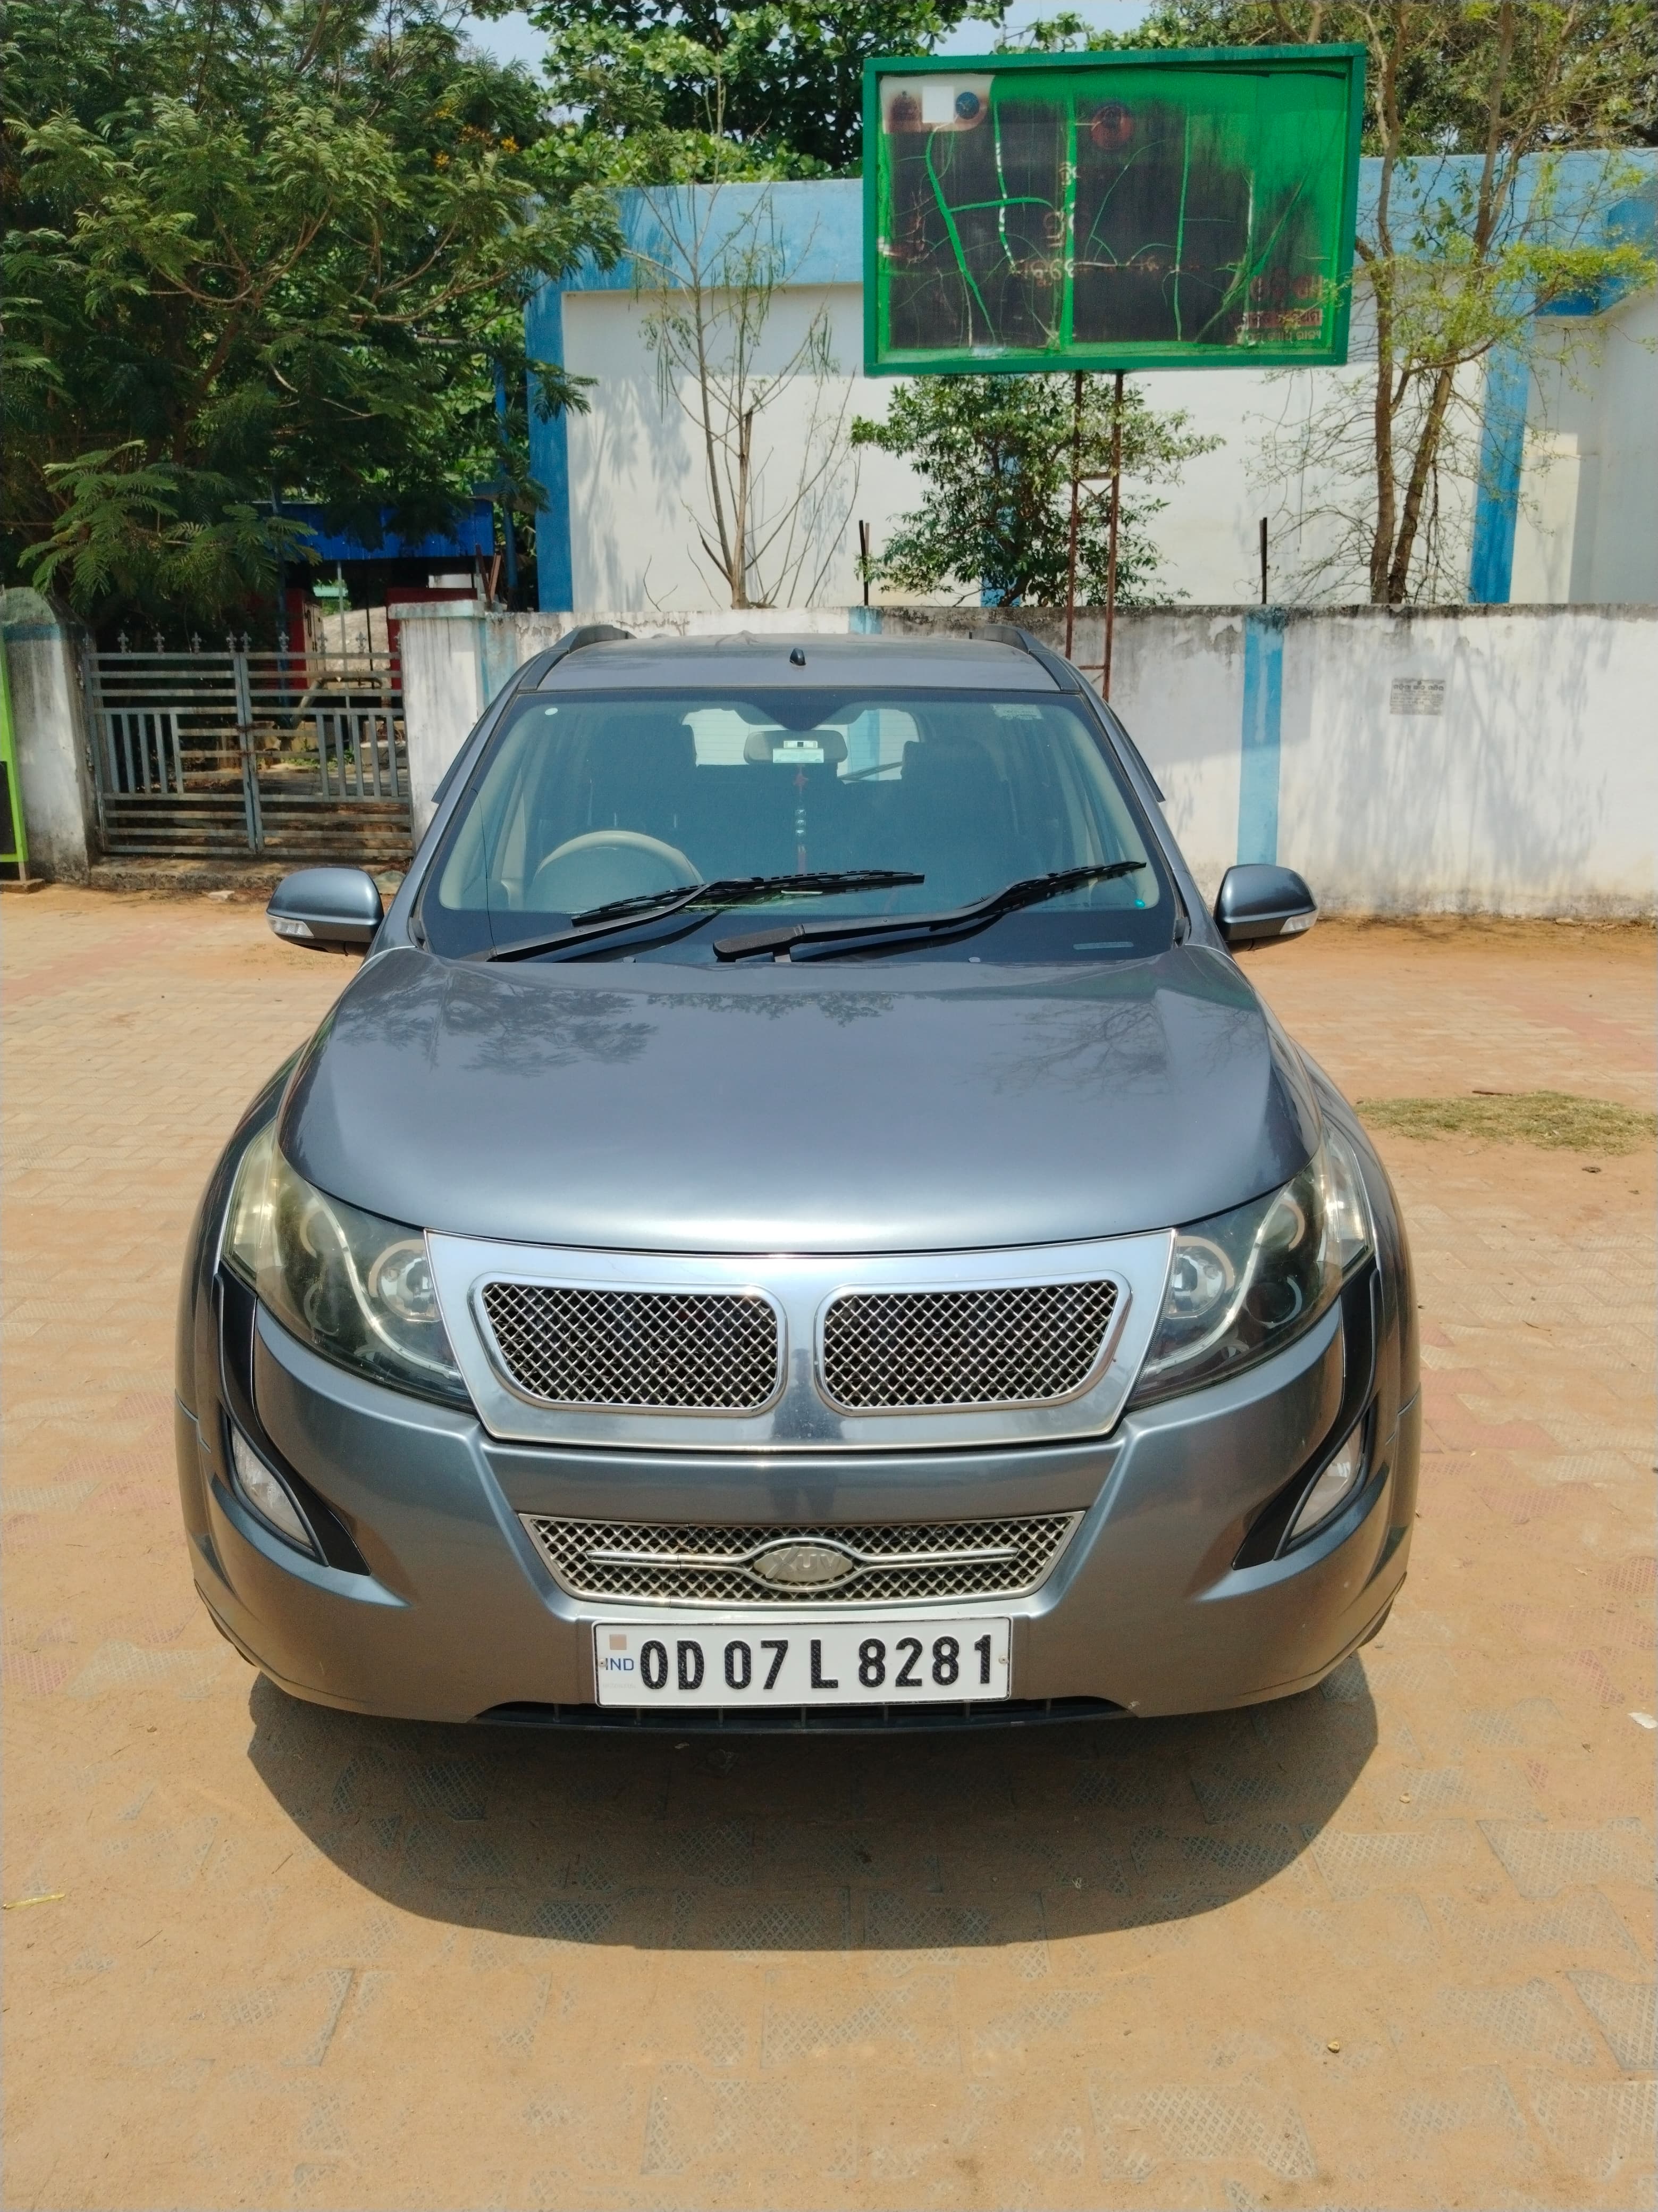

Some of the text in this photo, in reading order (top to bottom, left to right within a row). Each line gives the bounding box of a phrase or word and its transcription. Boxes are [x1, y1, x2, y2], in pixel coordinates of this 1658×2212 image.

[766, 1546, 841, 1579] XUV
[605, 1657, 634, 1671] IND
[639, 1634, 992, 1690] OD 07 L 8281
